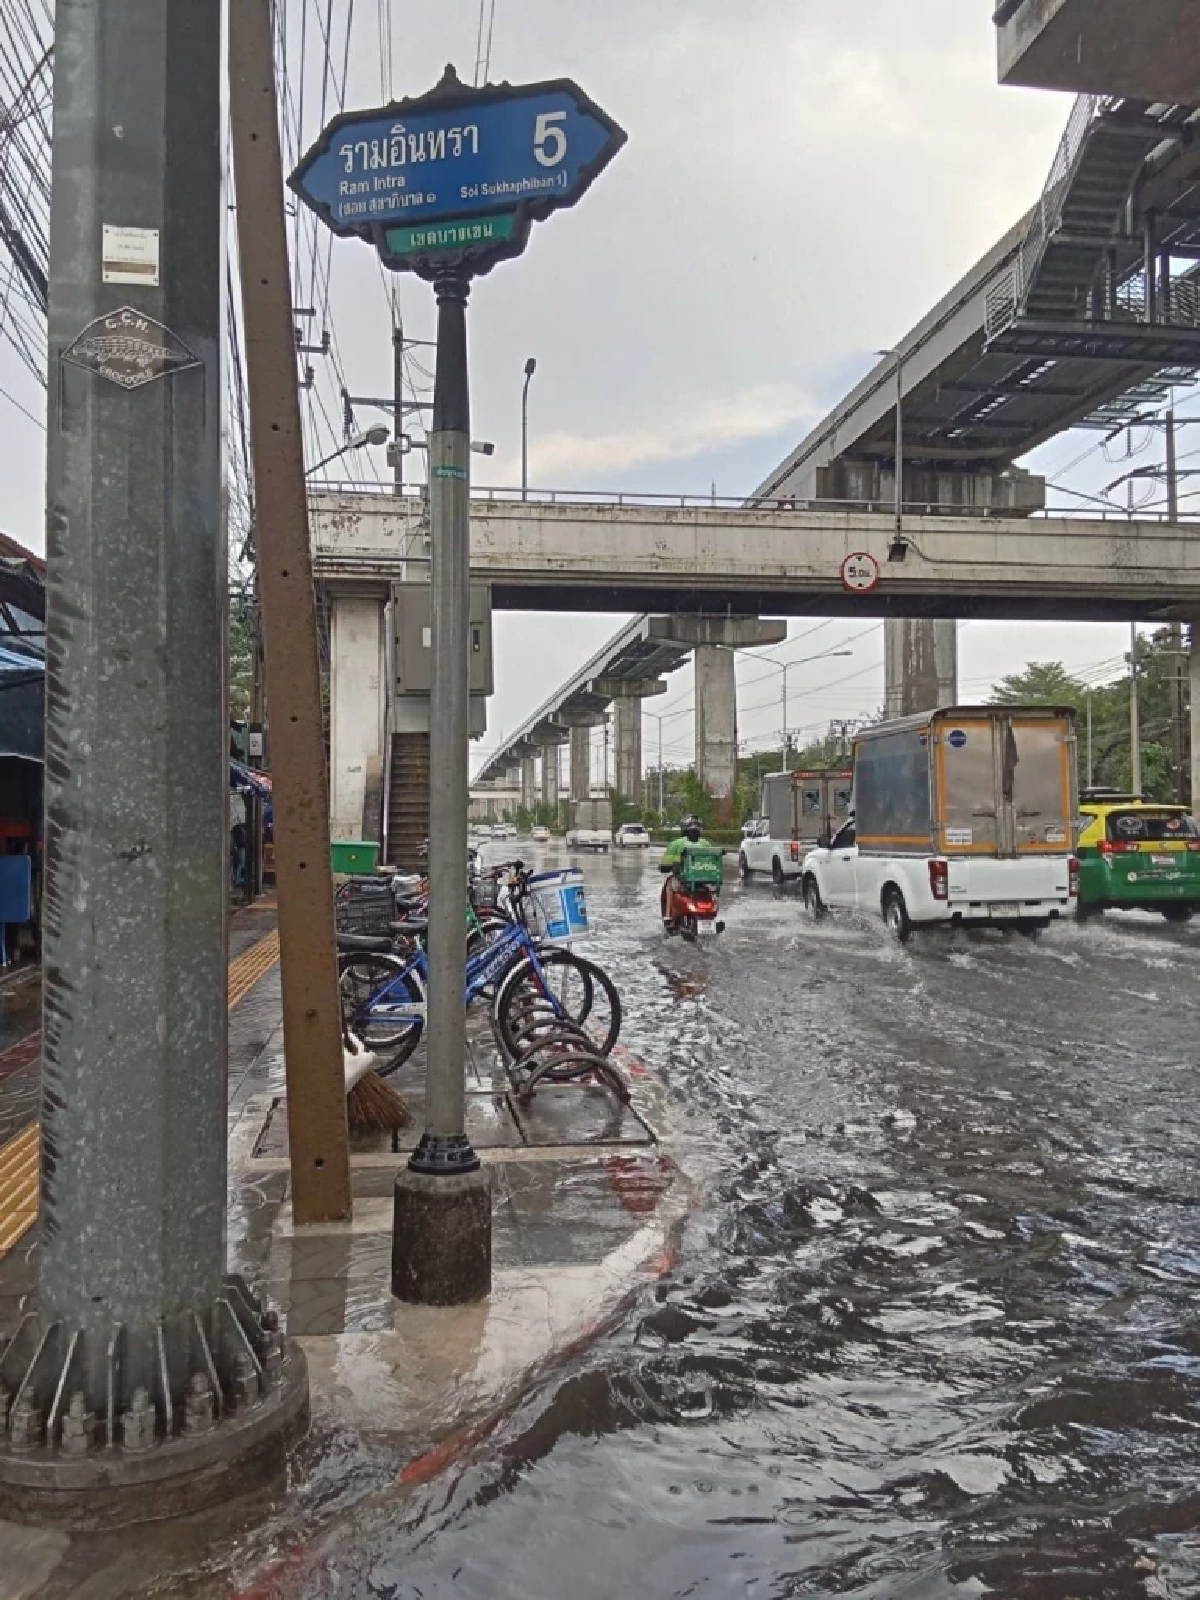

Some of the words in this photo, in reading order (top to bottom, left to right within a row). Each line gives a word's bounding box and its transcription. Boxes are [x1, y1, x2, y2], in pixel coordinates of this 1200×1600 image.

[339, 123, 478, 173] รามอินทรา
[533, 111, 567, 167] 5
[340, 180, 370, 197] Ram
[373, 175, 406, 192] Intra
[460, 184, 478, 199] Soi
[481, 177, 554, 196] Sukhaphiban
